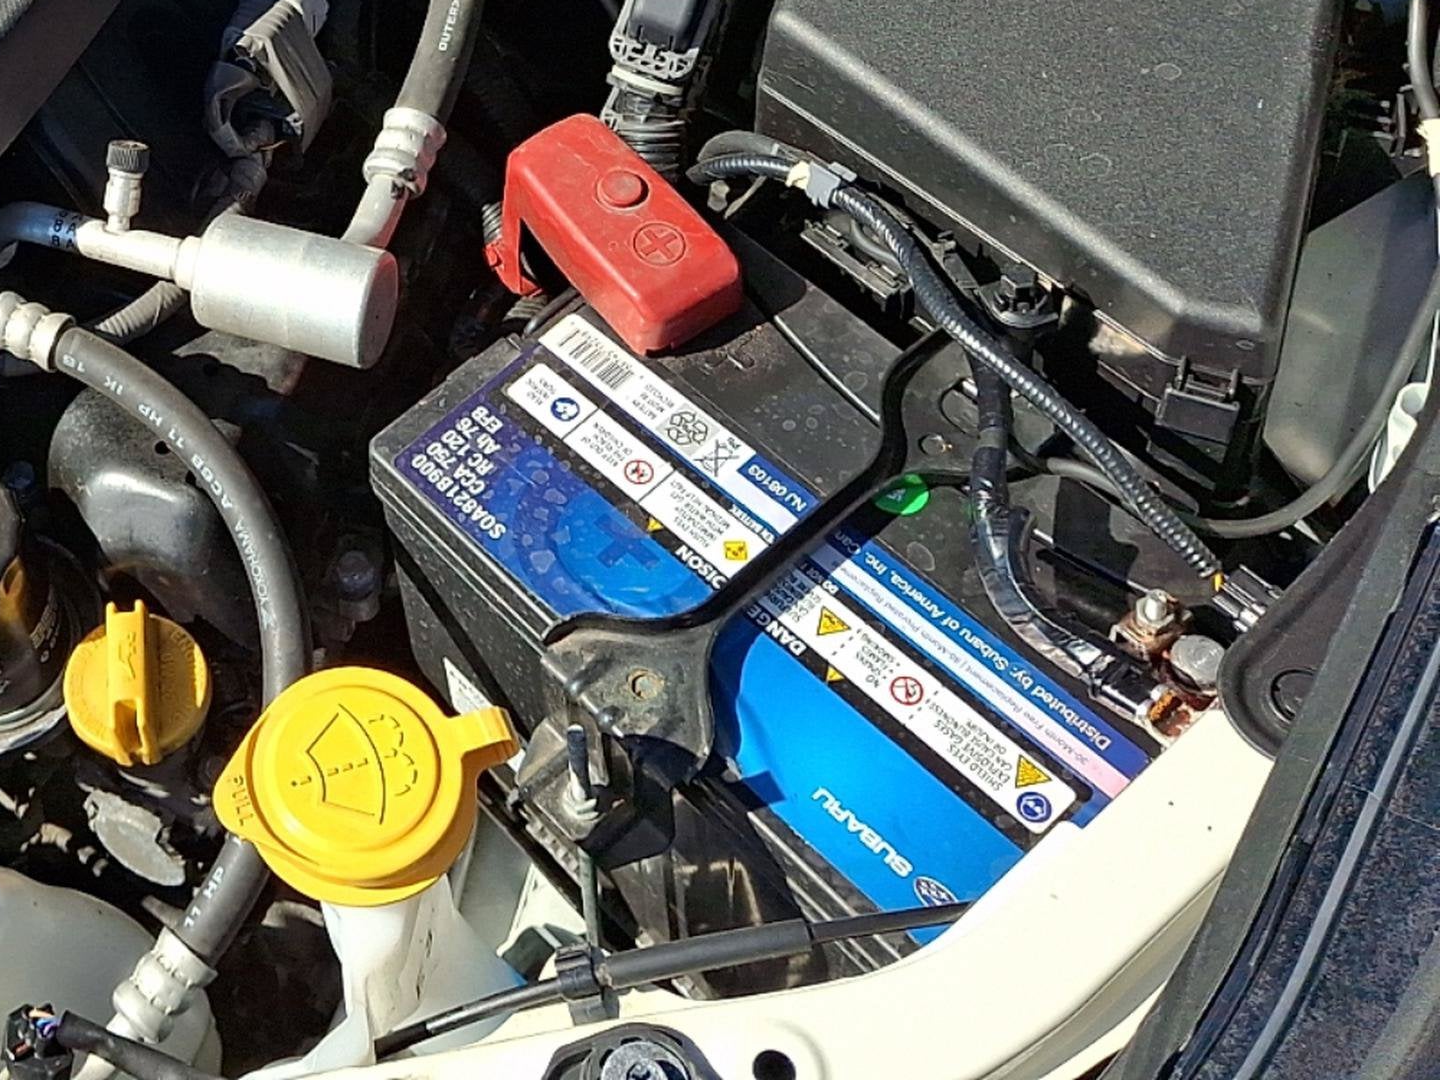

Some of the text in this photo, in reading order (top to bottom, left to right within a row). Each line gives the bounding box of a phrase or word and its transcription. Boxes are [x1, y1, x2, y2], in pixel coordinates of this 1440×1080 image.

[138, 403, 163, 427] HP
[454, 414, 502, 458] Ah 76
[469, 402, 504, 435] EFB
[424, 439, 487, 497] CCA 750
[439, 427, 494, 477] RC 120
[746, 462, 788, 498] 08103
[783, 489, 807, 512] NJ
[235, 519, 270, 606] YOKOHAMA
[860, 550, 887, 575] Inc.
[884, 569, 944, 621] America,
[940, 613, 961, 633] of
[957, 626, 1010, 672] Subaru
[1007, 663, 1035, 690] by:
[1029, 683, 1111, 750] Distributed
[932, 718, 1010, 784] EXPLOSIVE GASES
[231, 775, 254, 826] PULL
[809, 785, 915, 879] SUBARU
[203, 866, 224, 900] HP
